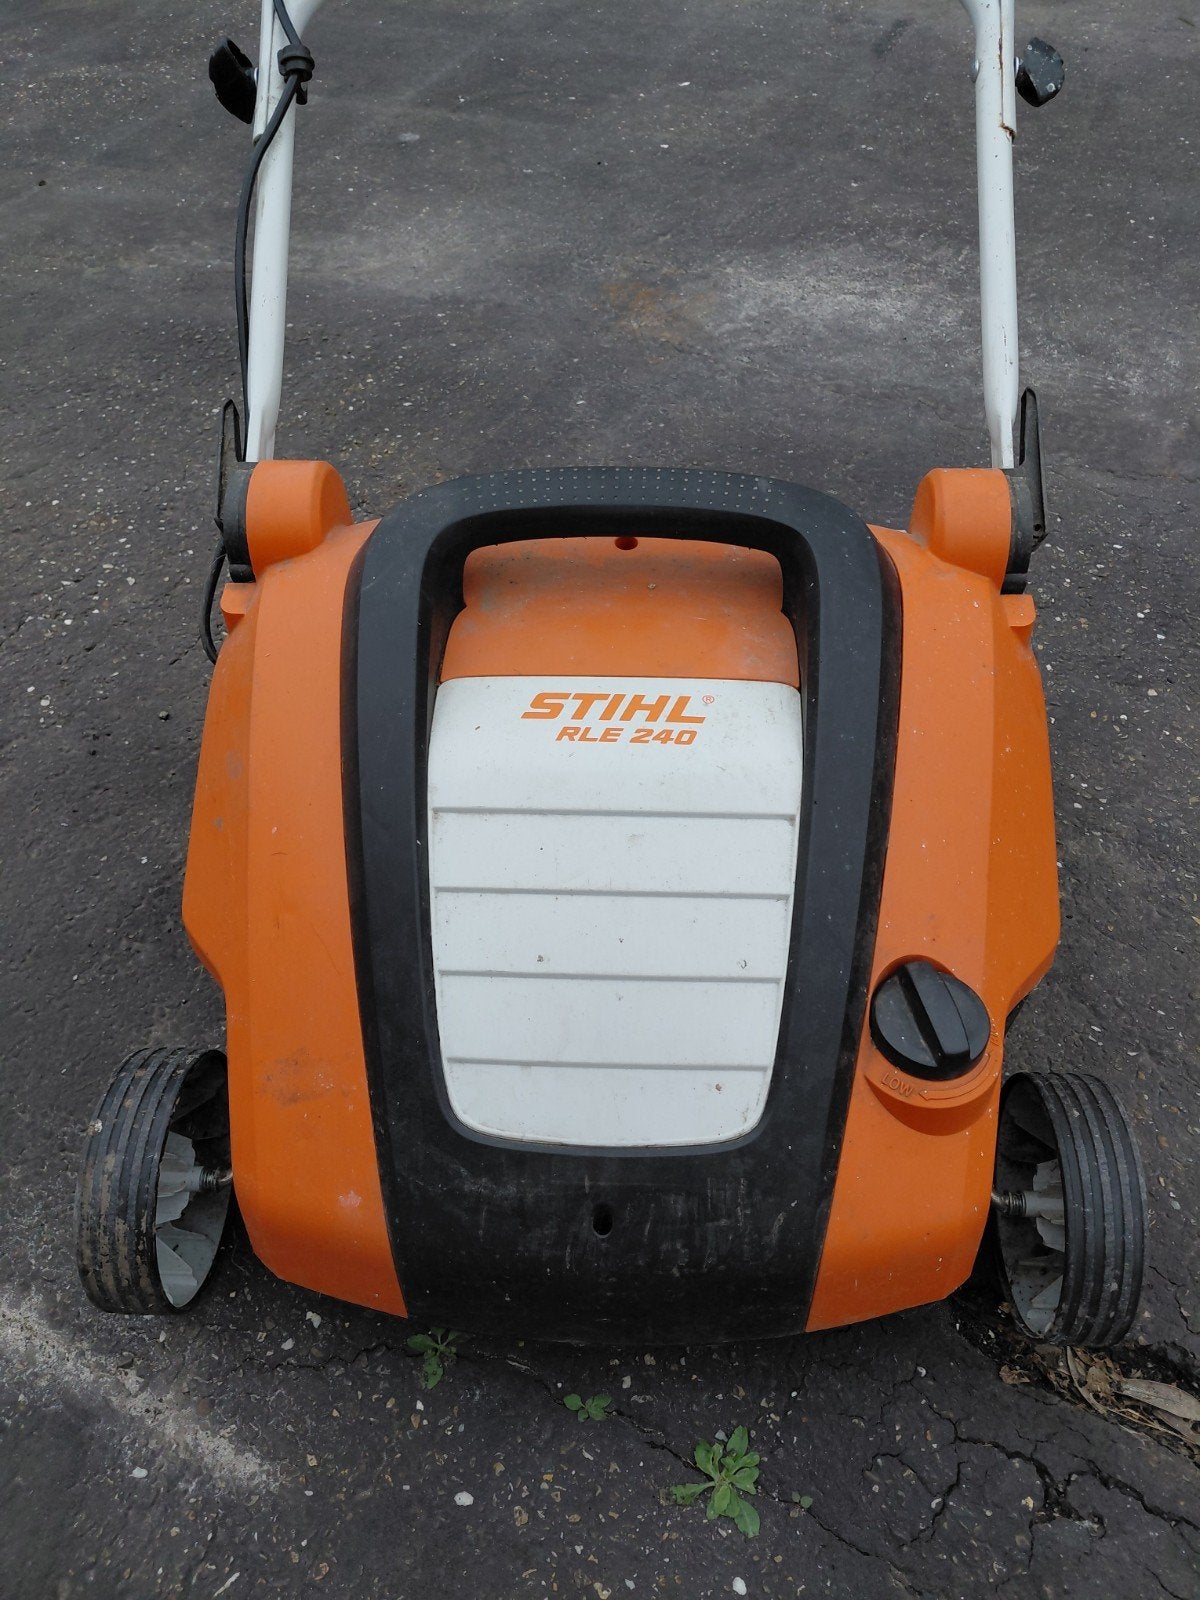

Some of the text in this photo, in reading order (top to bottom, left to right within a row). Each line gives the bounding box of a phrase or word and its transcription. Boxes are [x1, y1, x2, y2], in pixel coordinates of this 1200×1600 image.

[555, 726, 698, 745] RLE 240
[881, 1072, 914, 1097] LOW
